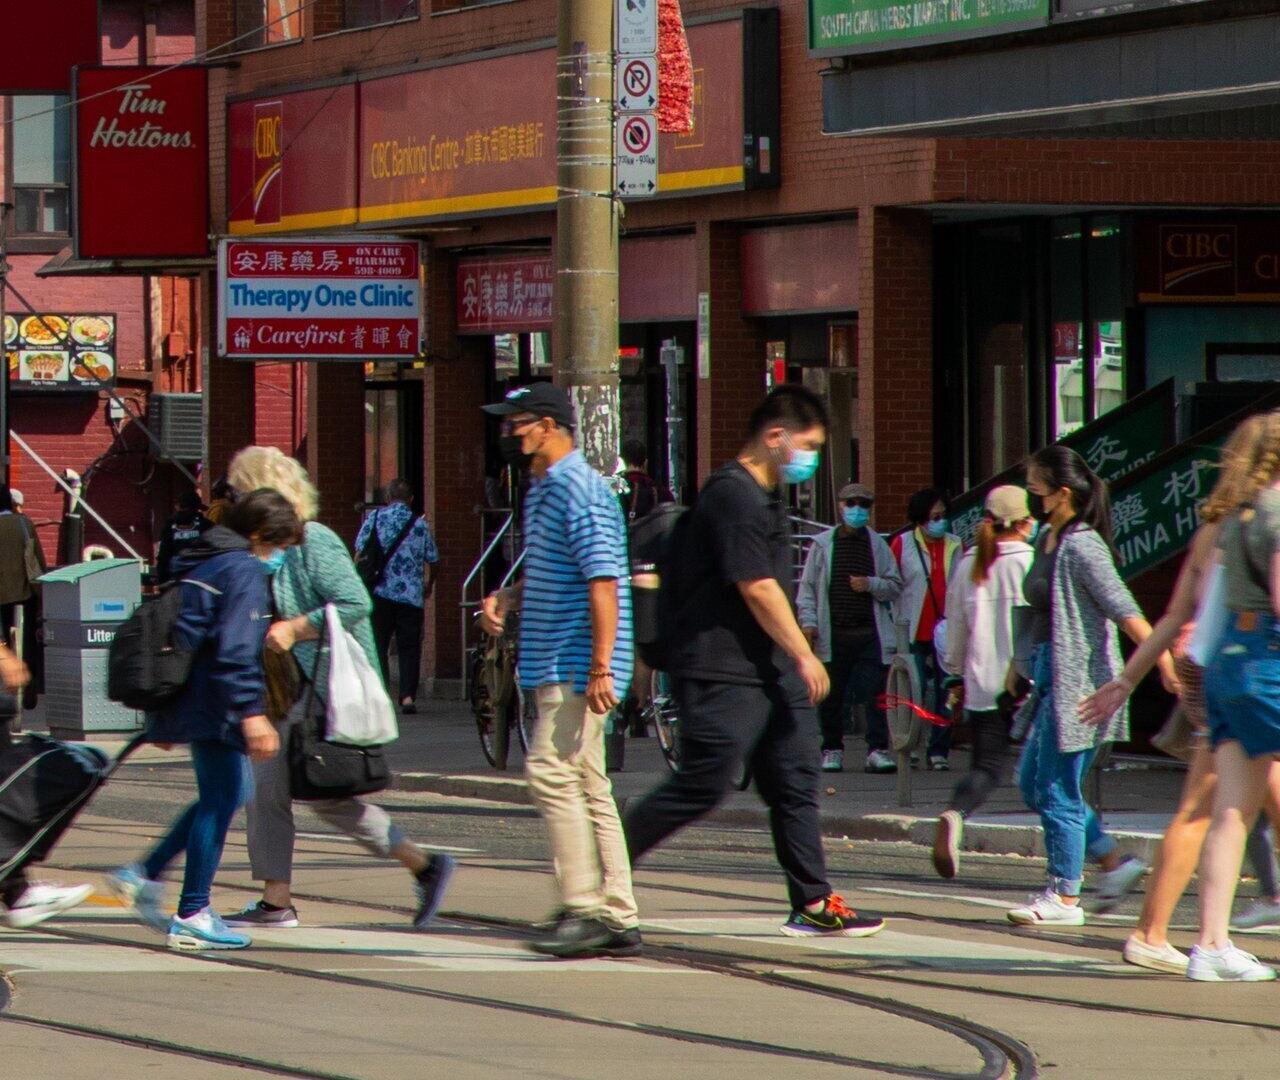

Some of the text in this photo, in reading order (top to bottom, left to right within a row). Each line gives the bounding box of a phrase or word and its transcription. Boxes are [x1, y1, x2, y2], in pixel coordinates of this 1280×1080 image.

[880, 3, 912, 31] HERBS
[117, 84, 167, 114] Tim
[90, 116, 191, 148] Hortons
[255, 116, 281, 160] CIBC
[371, 141, 391, 180] CIBC
[392, 135, 427, 183] Banking
[429, 134, 459, 172] Centre
[356, 247, 402, 256] ON CARE
[1166, 232, 1231, 258] CIBC
[233, 250, 343, 272] 安康藥房
[347, 257, 407, 266] PHARMACY
[230, 283, 414, 313] Therapy One Clinic
[256, 324, 345, 349] Carefirst
[87, 629, 116, 642] Litter
